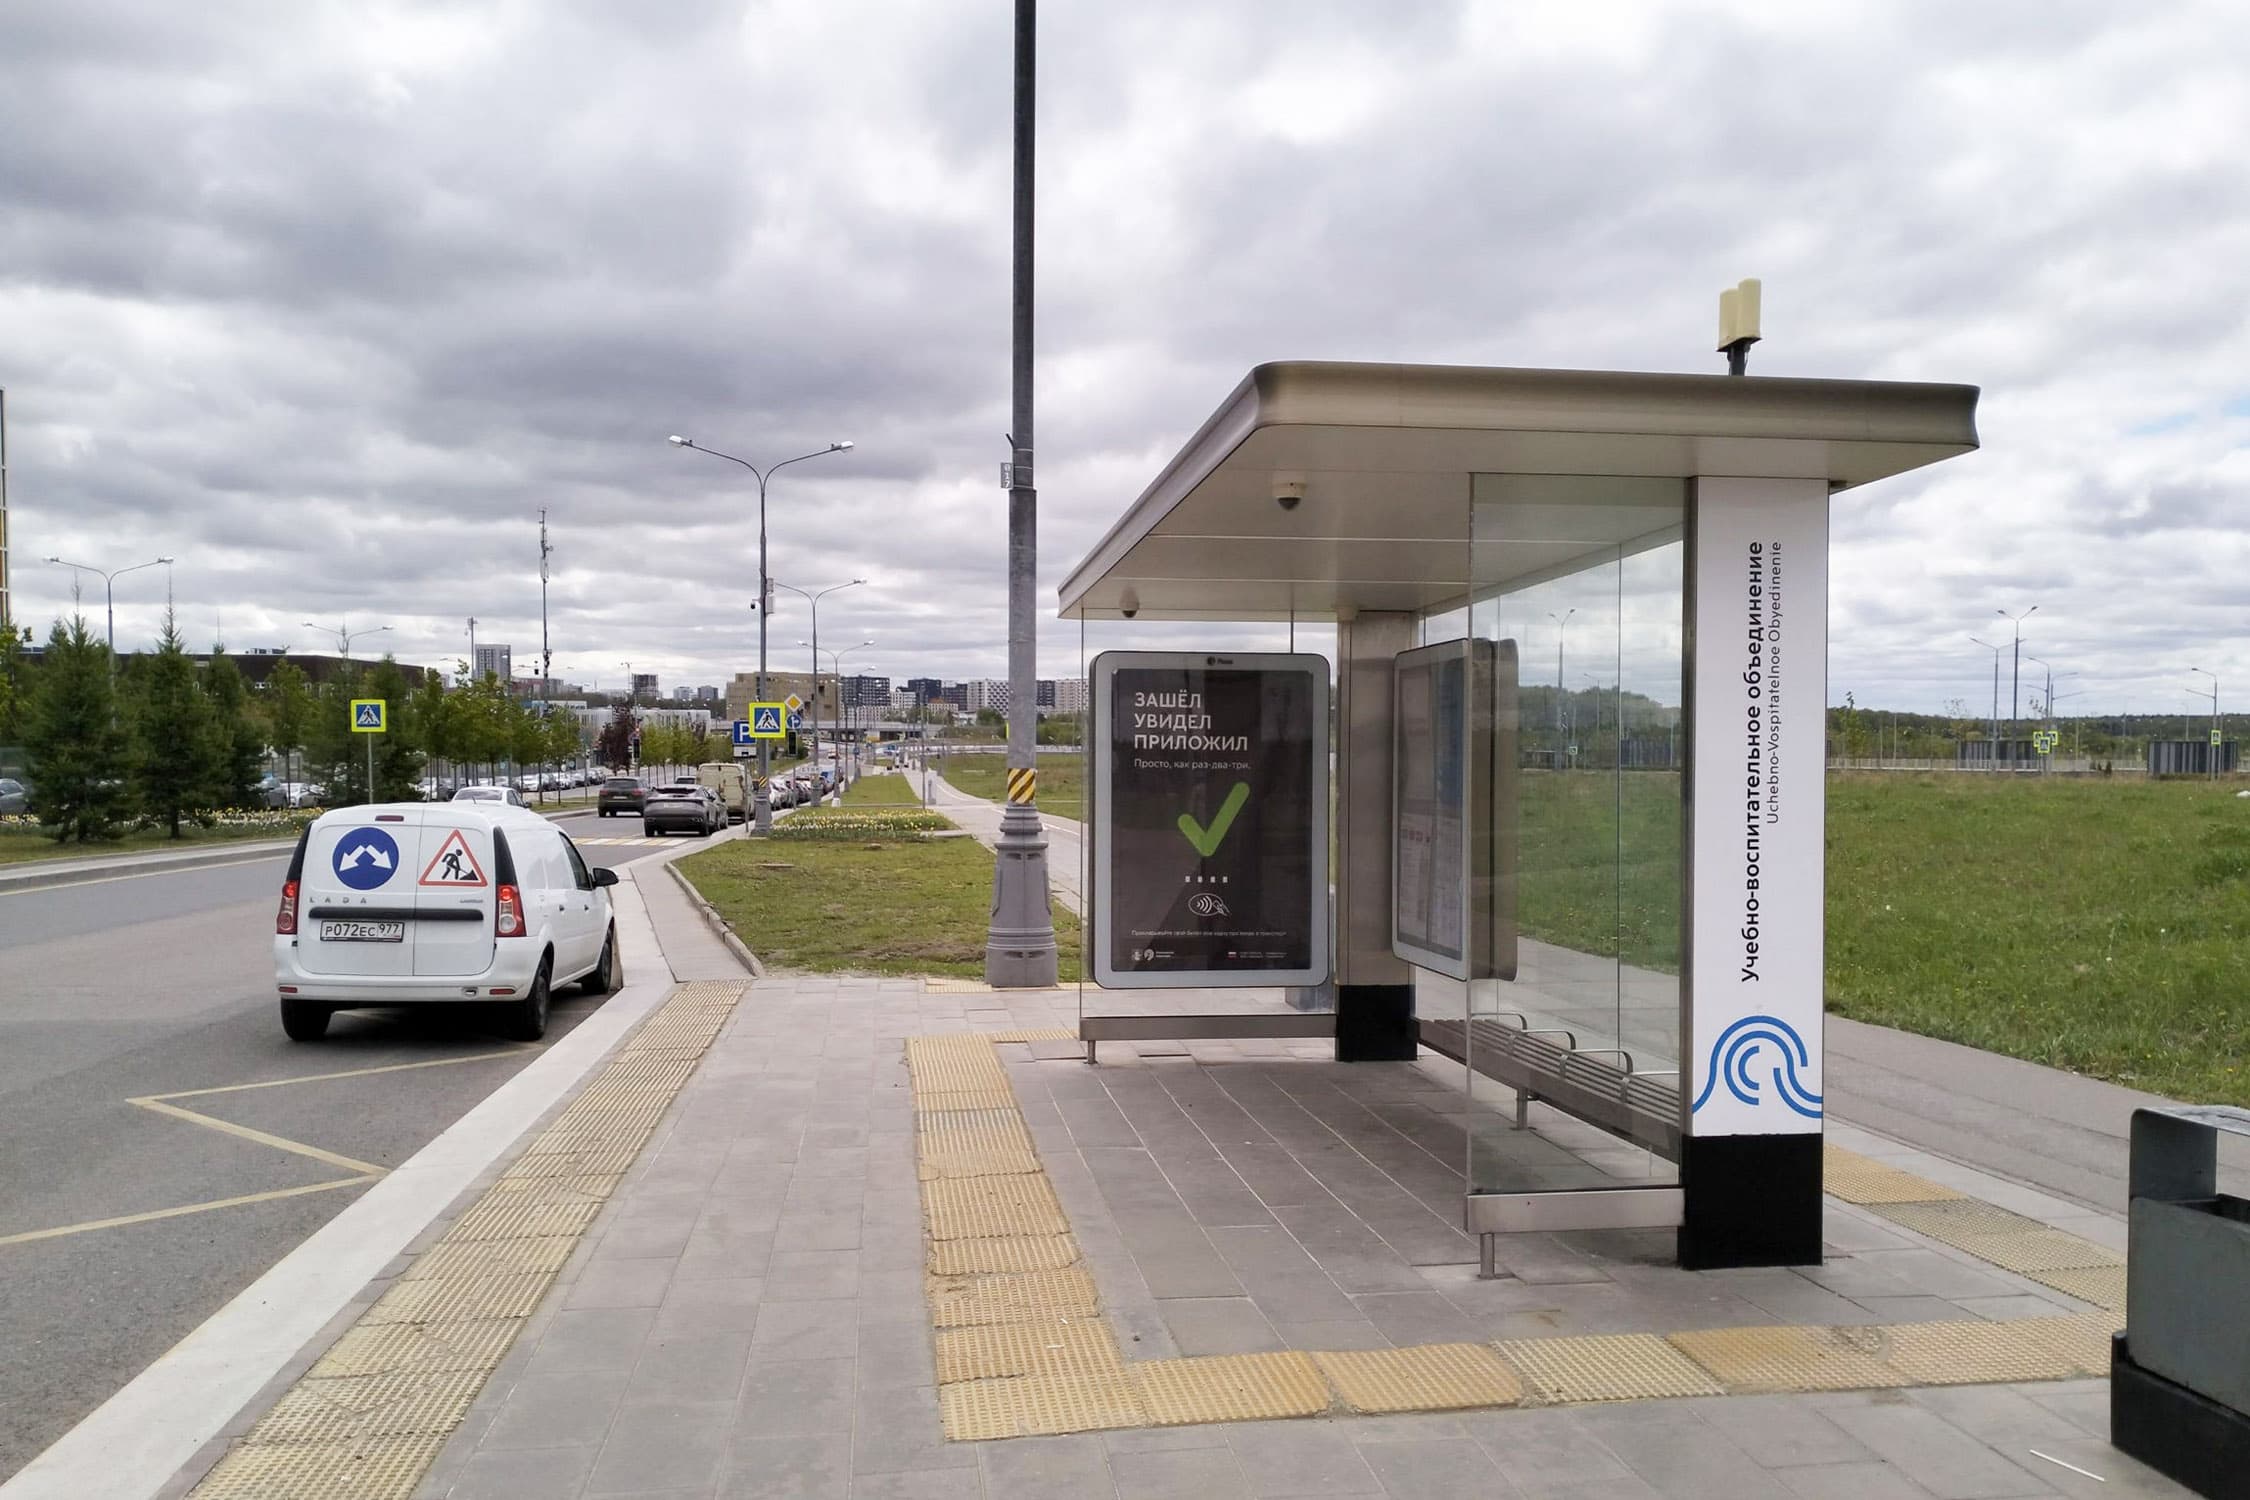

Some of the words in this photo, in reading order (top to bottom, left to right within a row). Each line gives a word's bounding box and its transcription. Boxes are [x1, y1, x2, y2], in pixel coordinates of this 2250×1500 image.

[1768, 541, 1783, 642] Obyedinenie
[1743, 541, 1764, 698] объединение
[1135, 689, 1201, 708] ЗАШЁЛ
[1134, 713, 1211, 731] УВИДЕЛ
[1134, 734, 1248, 751] ПРИЛОЖИЛ
[1766, 646, 1782, 823] Uchebno-Vospitatelnoe
[1134, 758, 1172, 769] Просто,
[1174, 760, 1190, 769] как
[1741, 705, 1761, 982] Учебно-воспитательное
[309, 897, 367, 905] LADA
